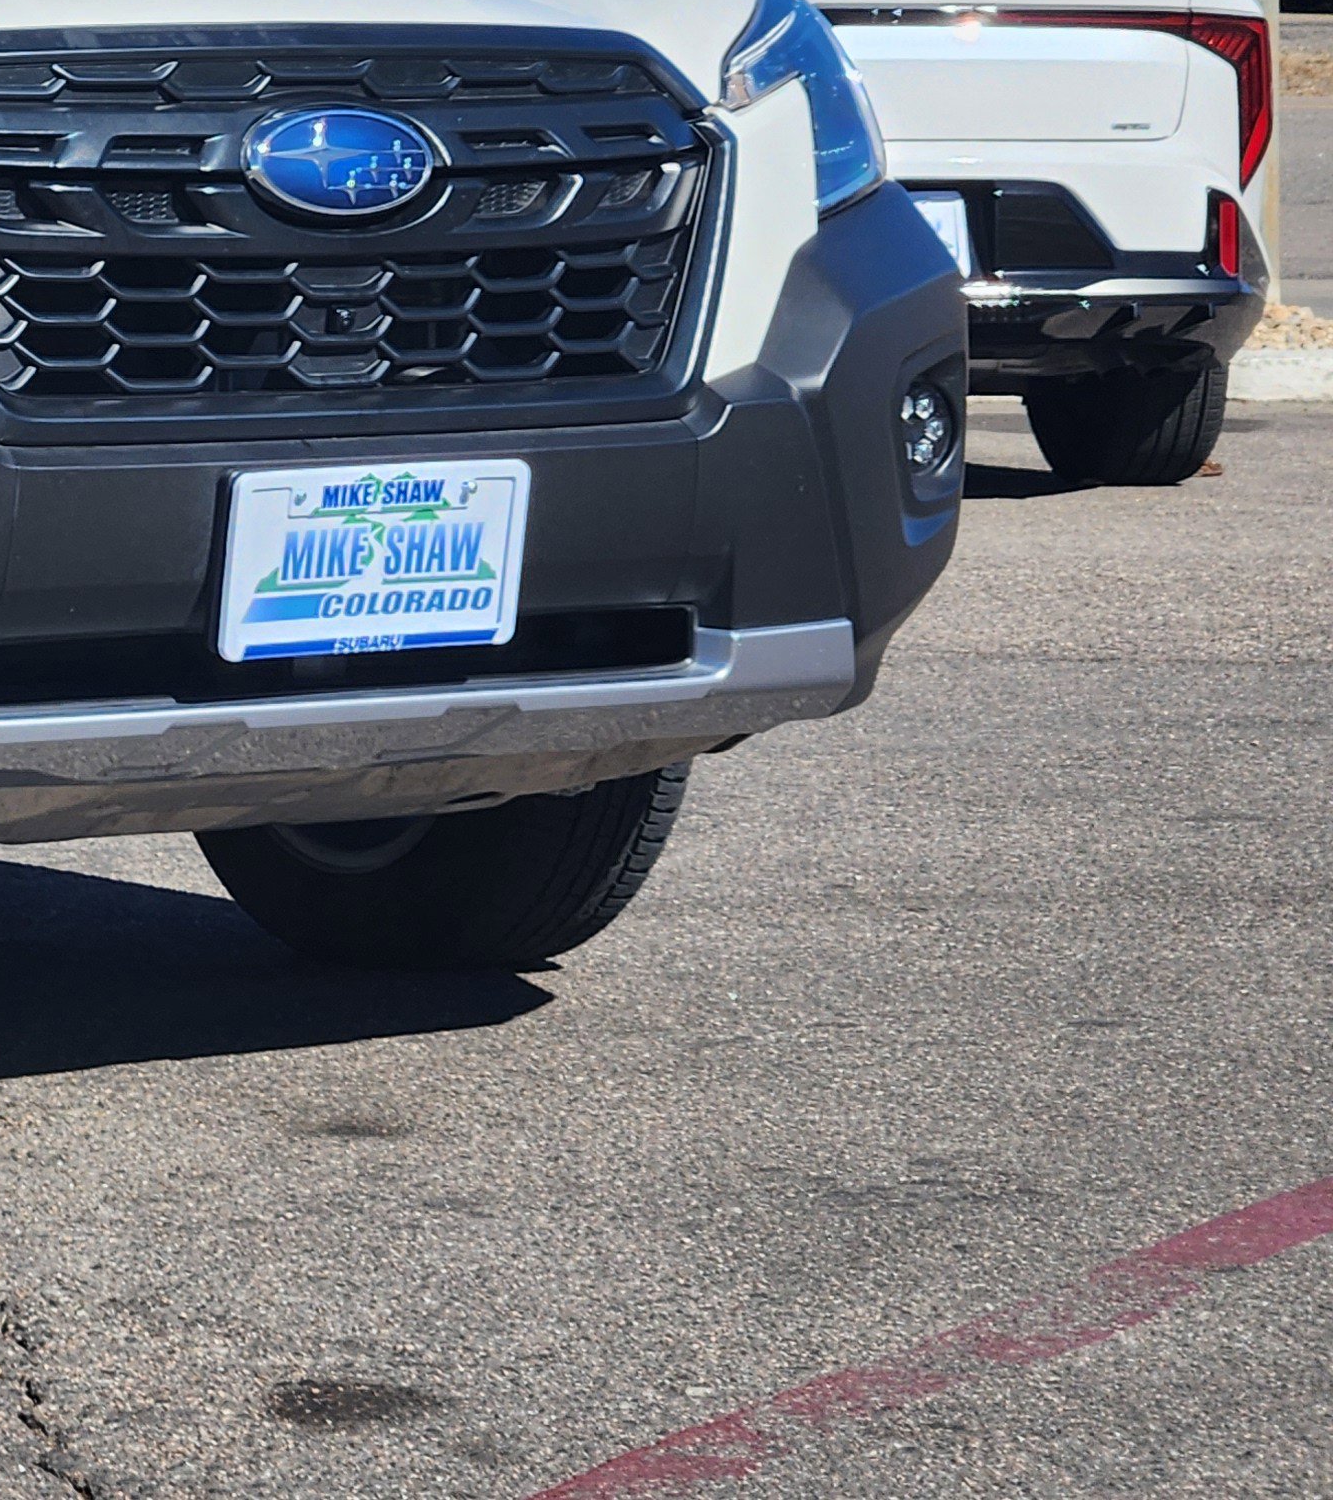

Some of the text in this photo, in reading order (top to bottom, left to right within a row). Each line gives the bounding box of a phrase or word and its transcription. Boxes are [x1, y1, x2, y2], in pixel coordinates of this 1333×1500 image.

[320, 478, 446, 509] MIKE SHAW
[281, 520, 485, 581] MIKE SHAW
[319, 586, 494, 619] COLORADO
[335, 634, 403, 650] SUBARU
